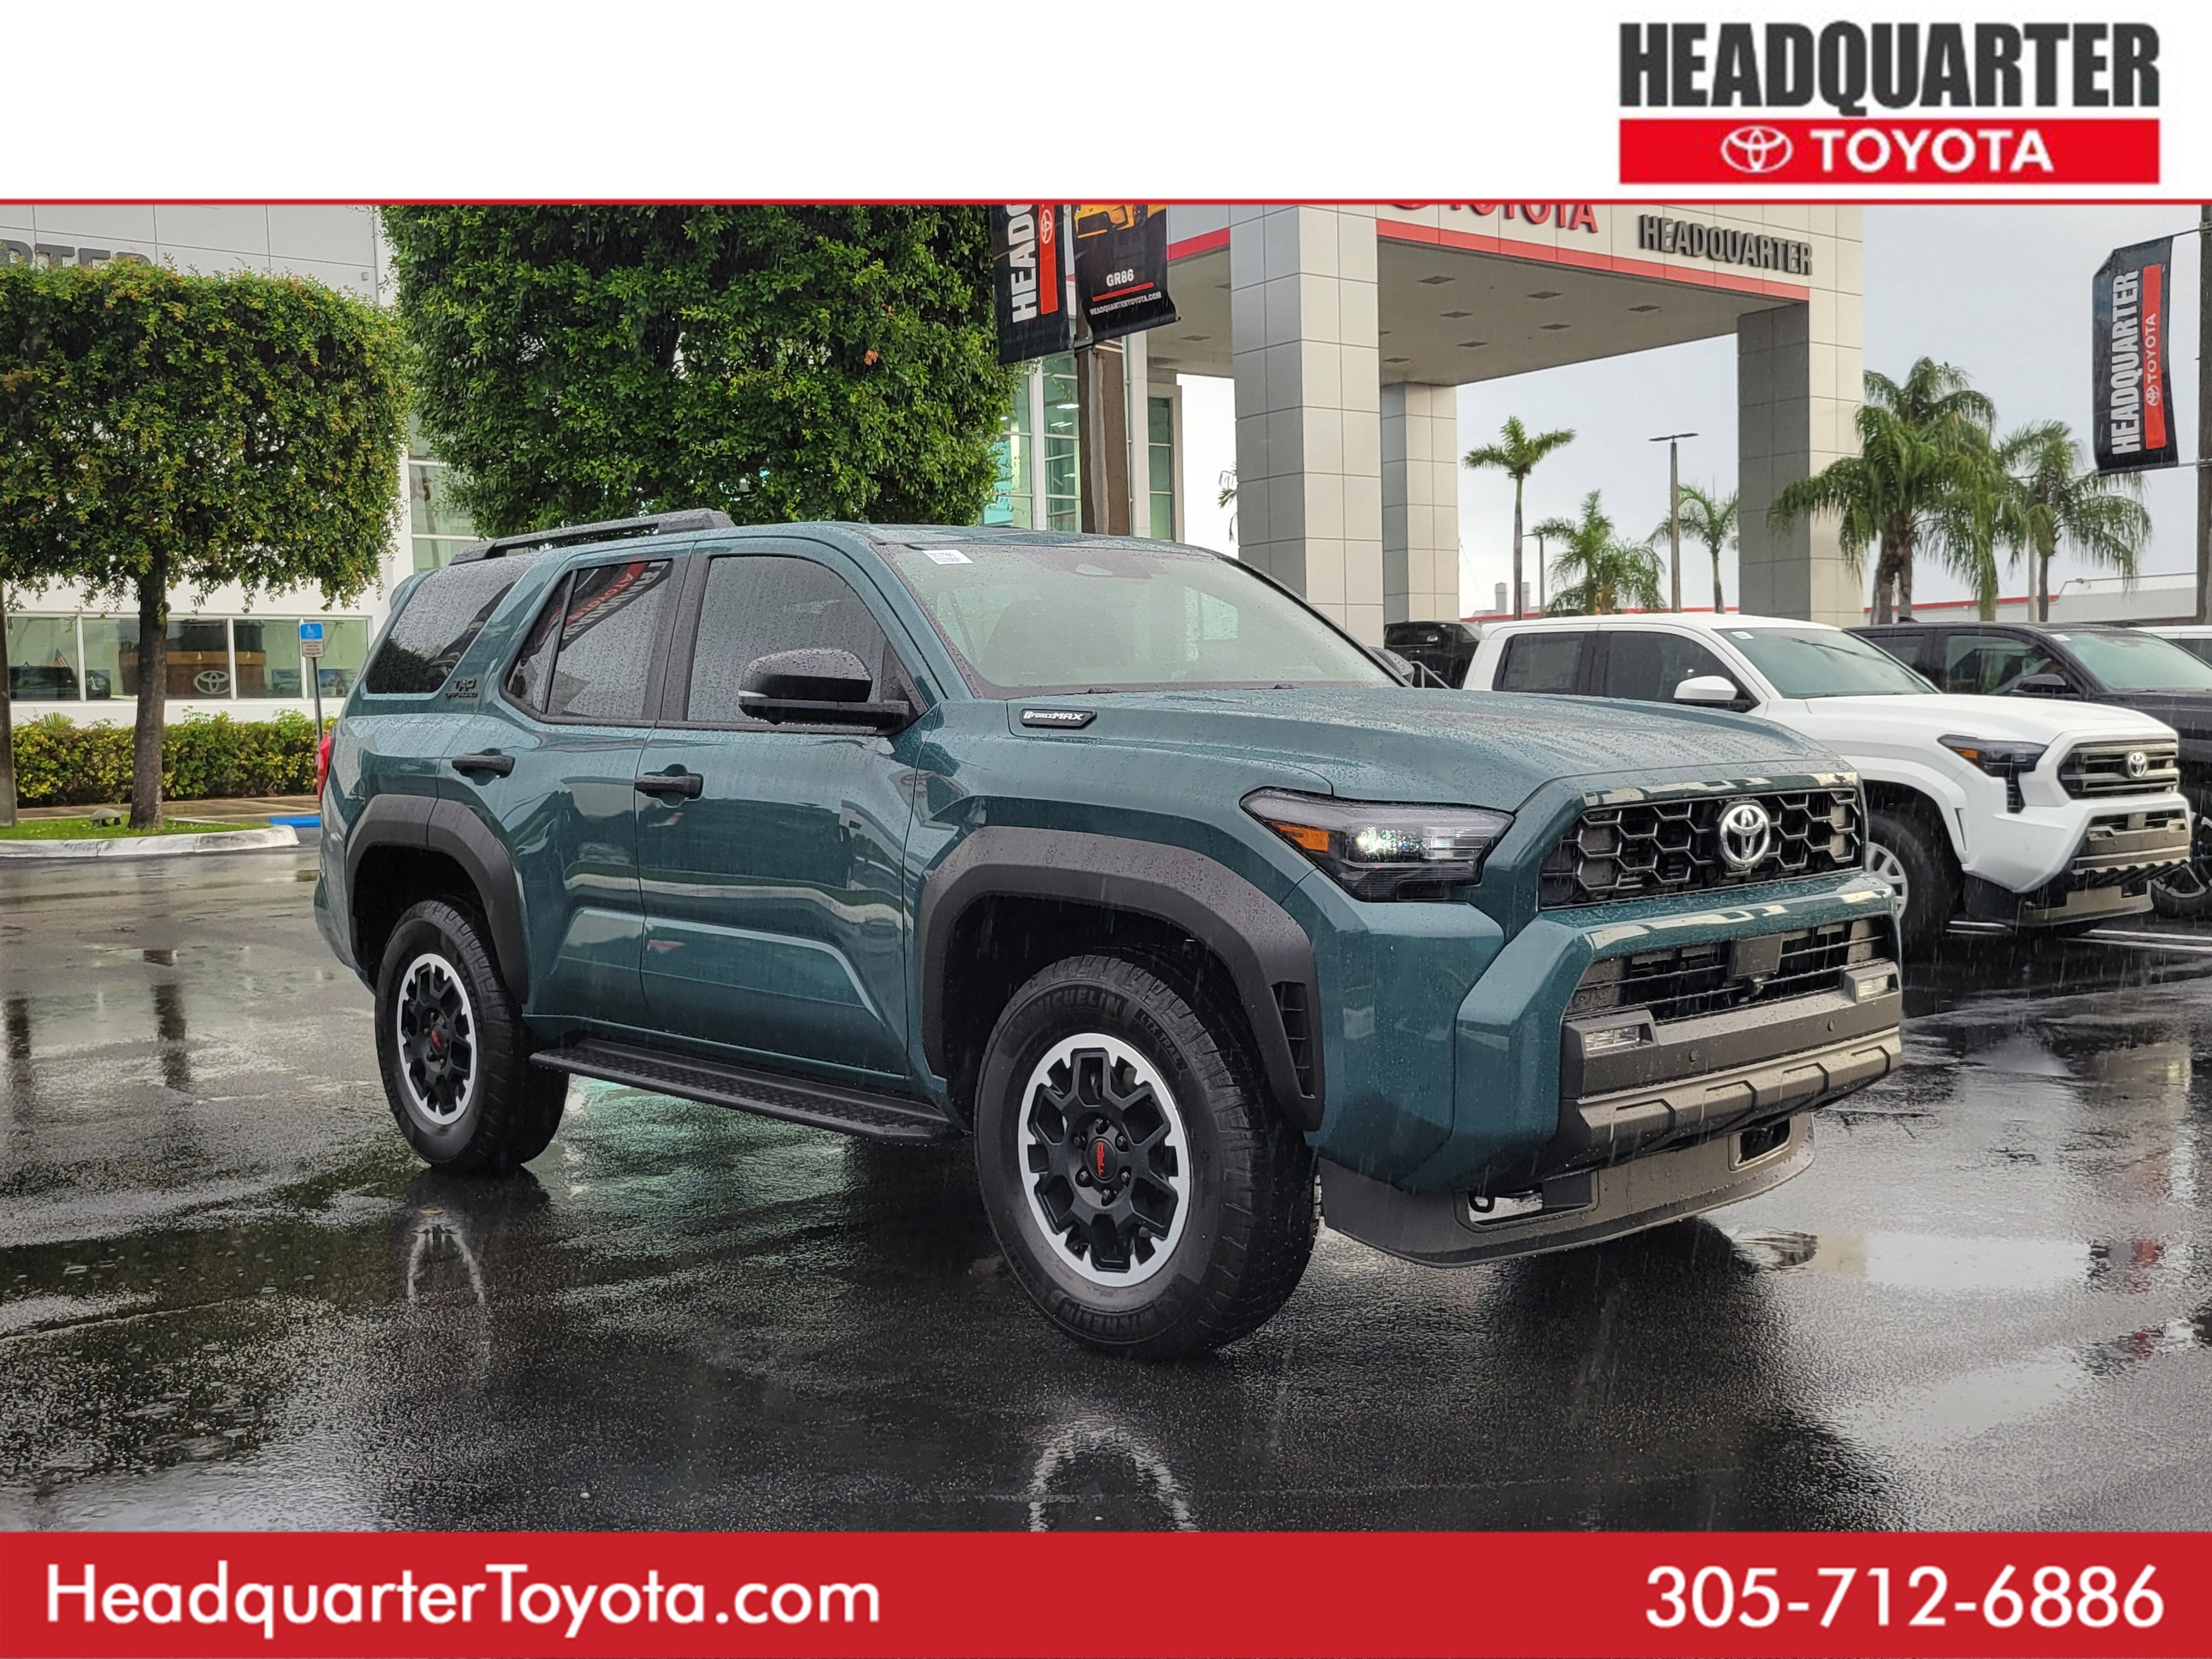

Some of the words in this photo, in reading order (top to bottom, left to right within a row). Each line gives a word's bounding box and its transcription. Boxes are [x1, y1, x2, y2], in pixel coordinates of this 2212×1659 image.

[1638, 214, 1813, 275] HEADQUARTER
[1089, 291, 1163, 316] HEADQUARTERTOYOTA.COM
[1106, 268, 1135, 287] GR86
[2111, 270, 2143, 455] HEADQUARTER
[2145, 313, 2158, 383] TOYOTA
[1141, 1013, 1160, 1034] LTX
[1159, 1032, 1181, 1063] TRAIL
